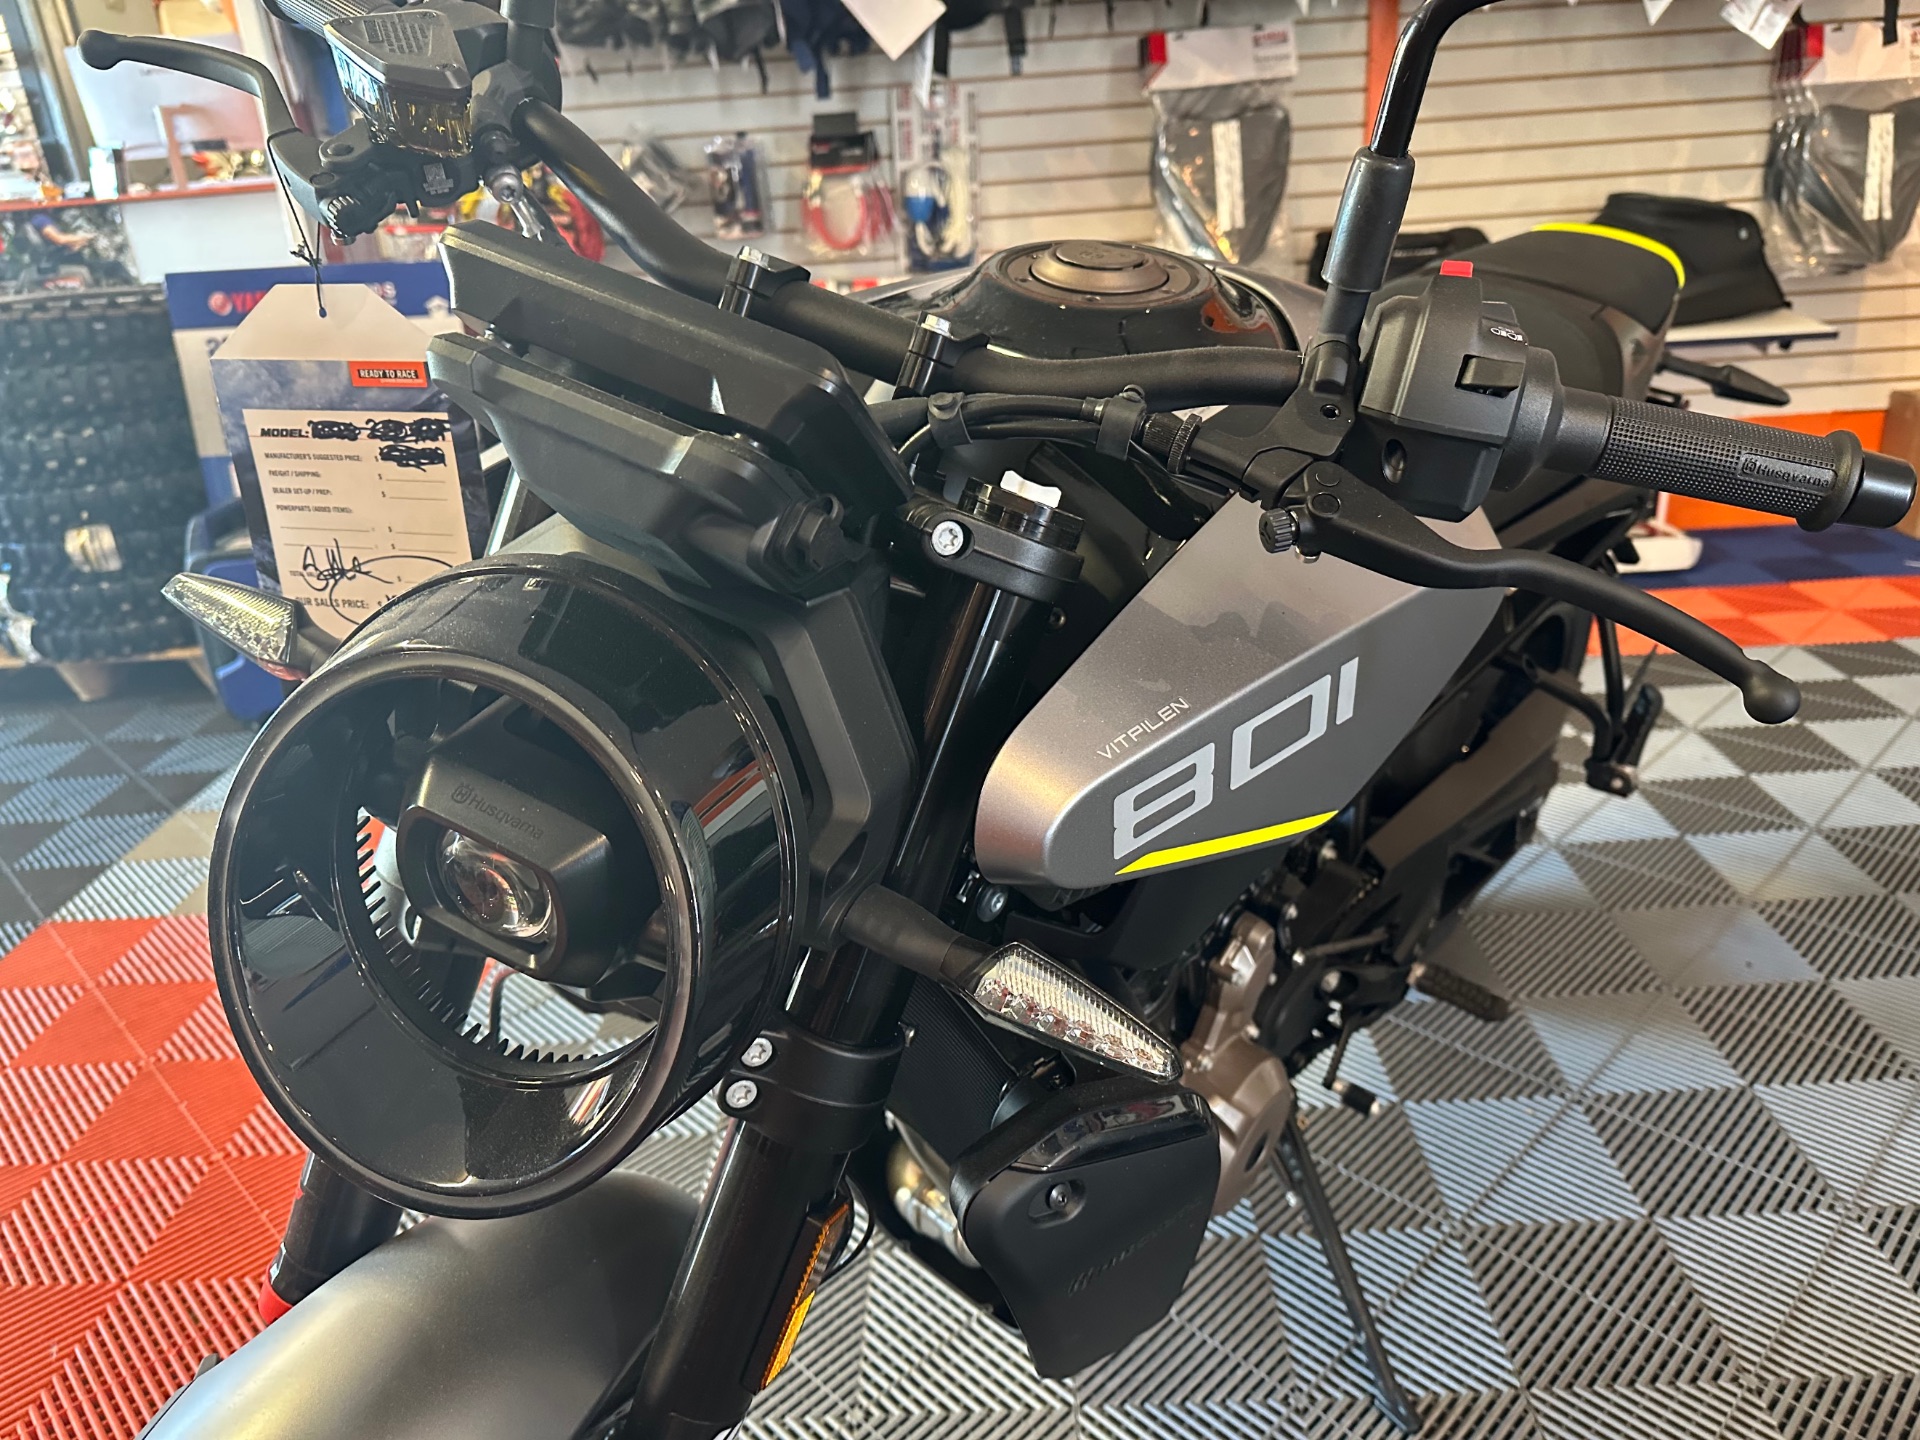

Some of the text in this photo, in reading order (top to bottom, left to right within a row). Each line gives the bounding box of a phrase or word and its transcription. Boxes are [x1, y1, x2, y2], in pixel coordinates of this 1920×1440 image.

[359, 369, 417, 379] READY TO RACE
[260, 428, 310, 438] MODEL:
[1756, 464, 1830, 488] Husqvarna
[341, 599, 370, 609] PRICE:
[1096, 696, 1191, 760] VITPILEN
[1113, 656, 1360, 860] 801
[467, 793, 545, 840] Husqvarna
